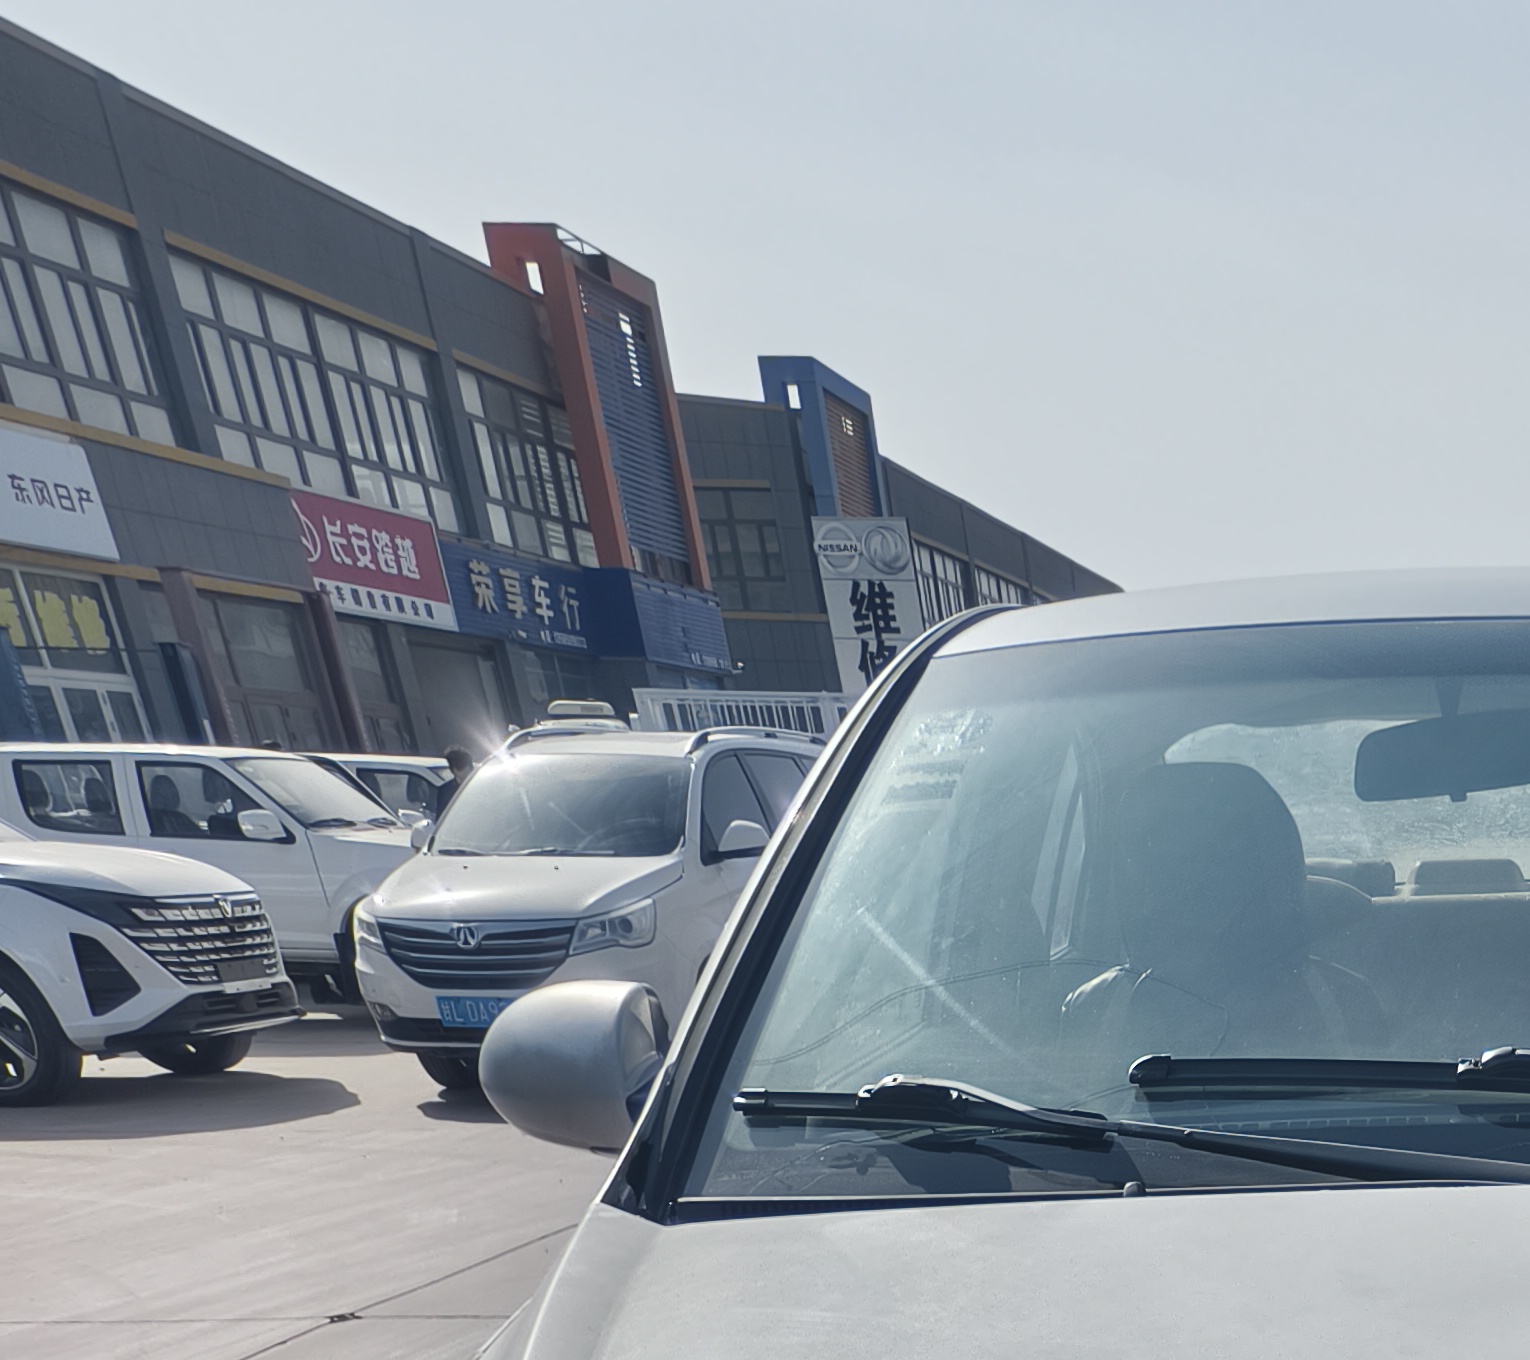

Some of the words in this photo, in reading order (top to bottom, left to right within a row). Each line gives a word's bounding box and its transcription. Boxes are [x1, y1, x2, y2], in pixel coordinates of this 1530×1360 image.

[7, 474, 94, 514] 东风日产
[322, 515, 421, 580] 长安跨越
[818, 544, 858, 553] NISSAN
[468, 559, 581, 630] 荣享车行
